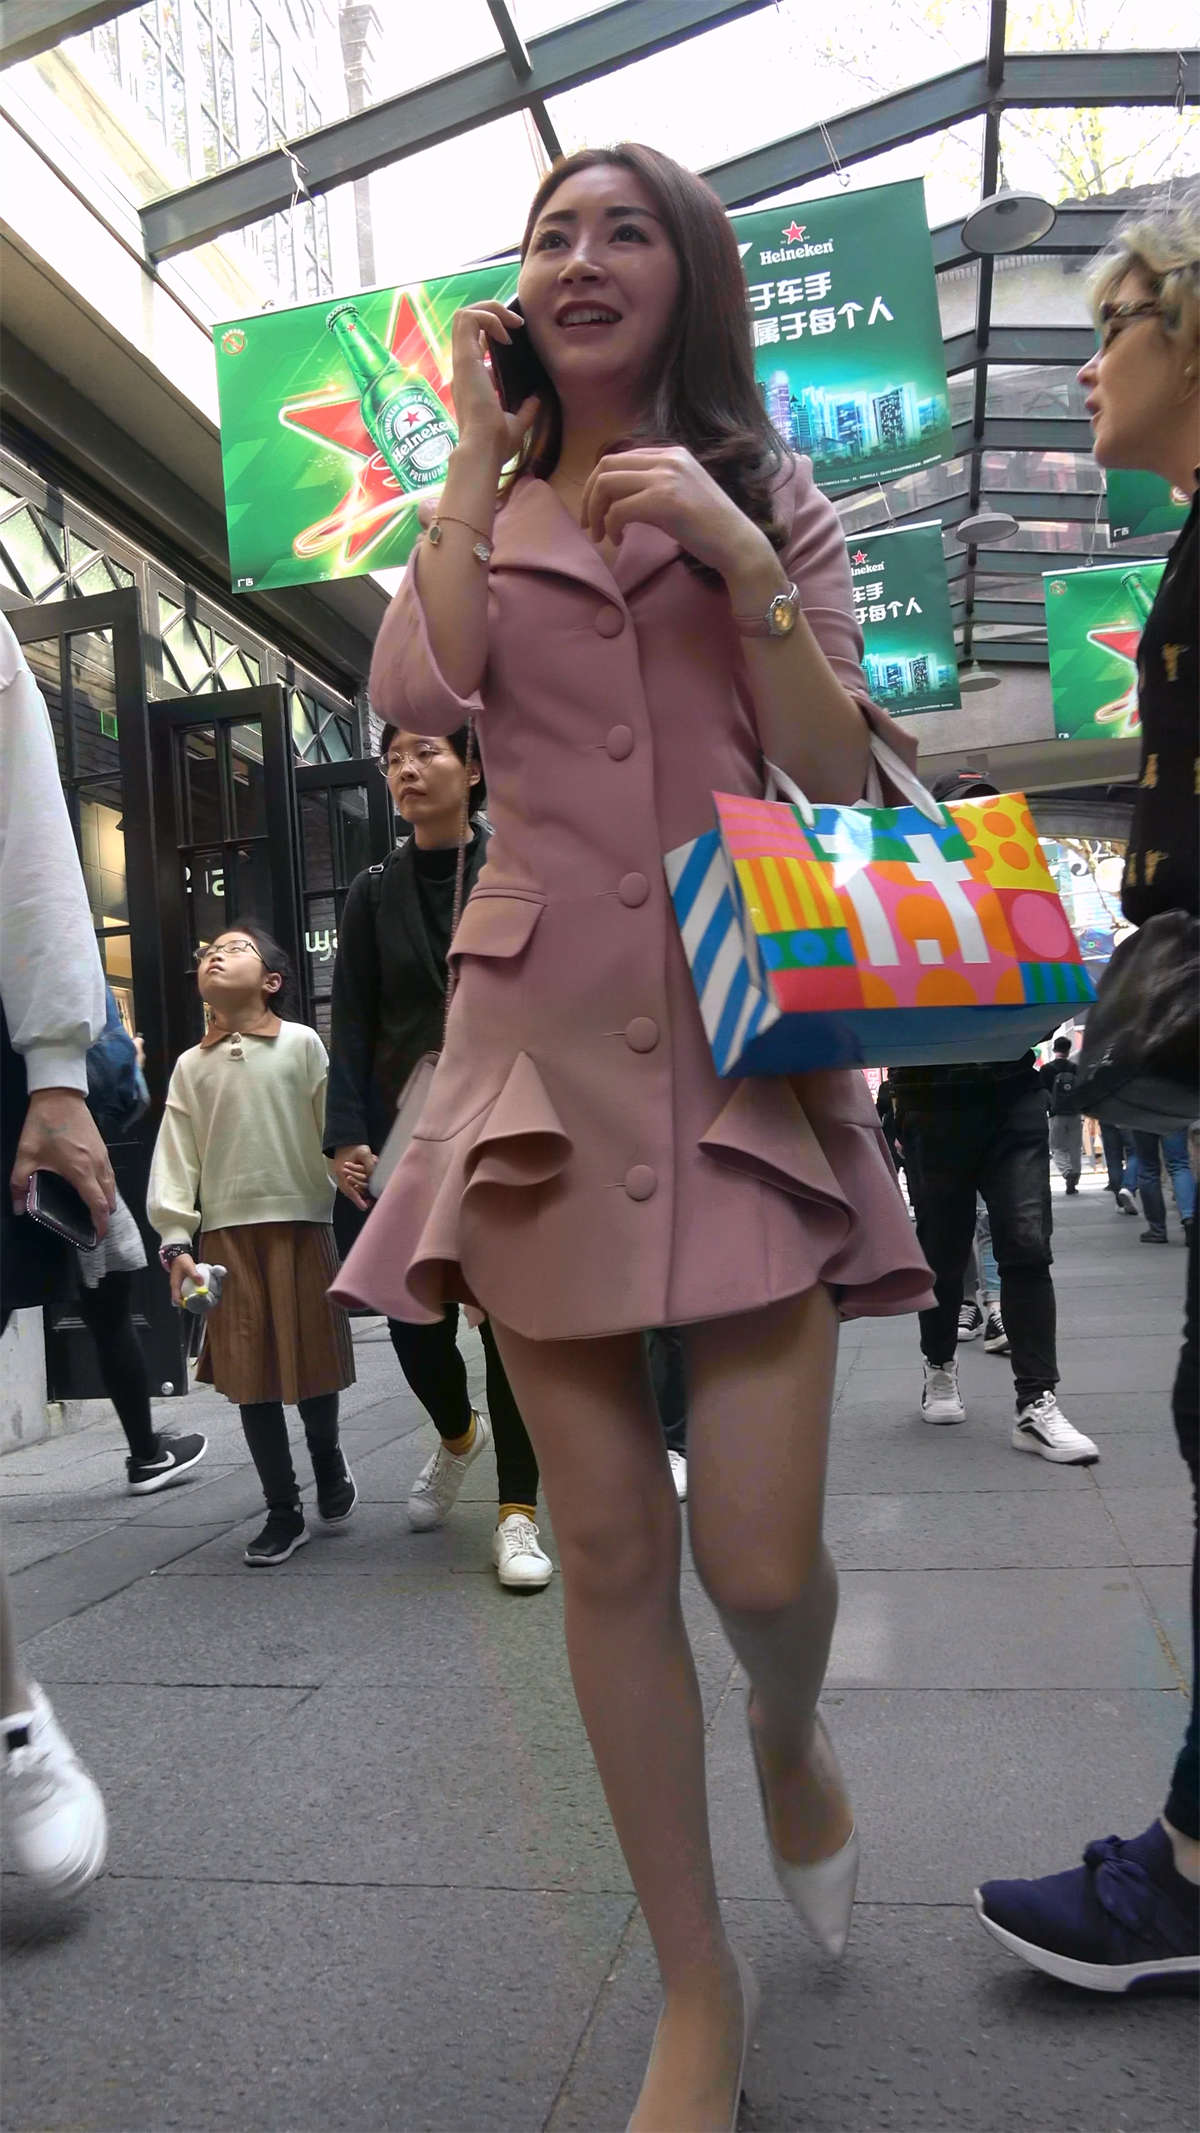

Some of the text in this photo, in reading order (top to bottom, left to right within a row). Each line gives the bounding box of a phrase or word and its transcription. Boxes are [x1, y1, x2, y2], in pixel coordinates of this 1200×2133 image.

[760, 242, 834, 266] Heineken
[751, 295, 894, 348] 属于每个人
[390, 420, 453, 462] Heineke
